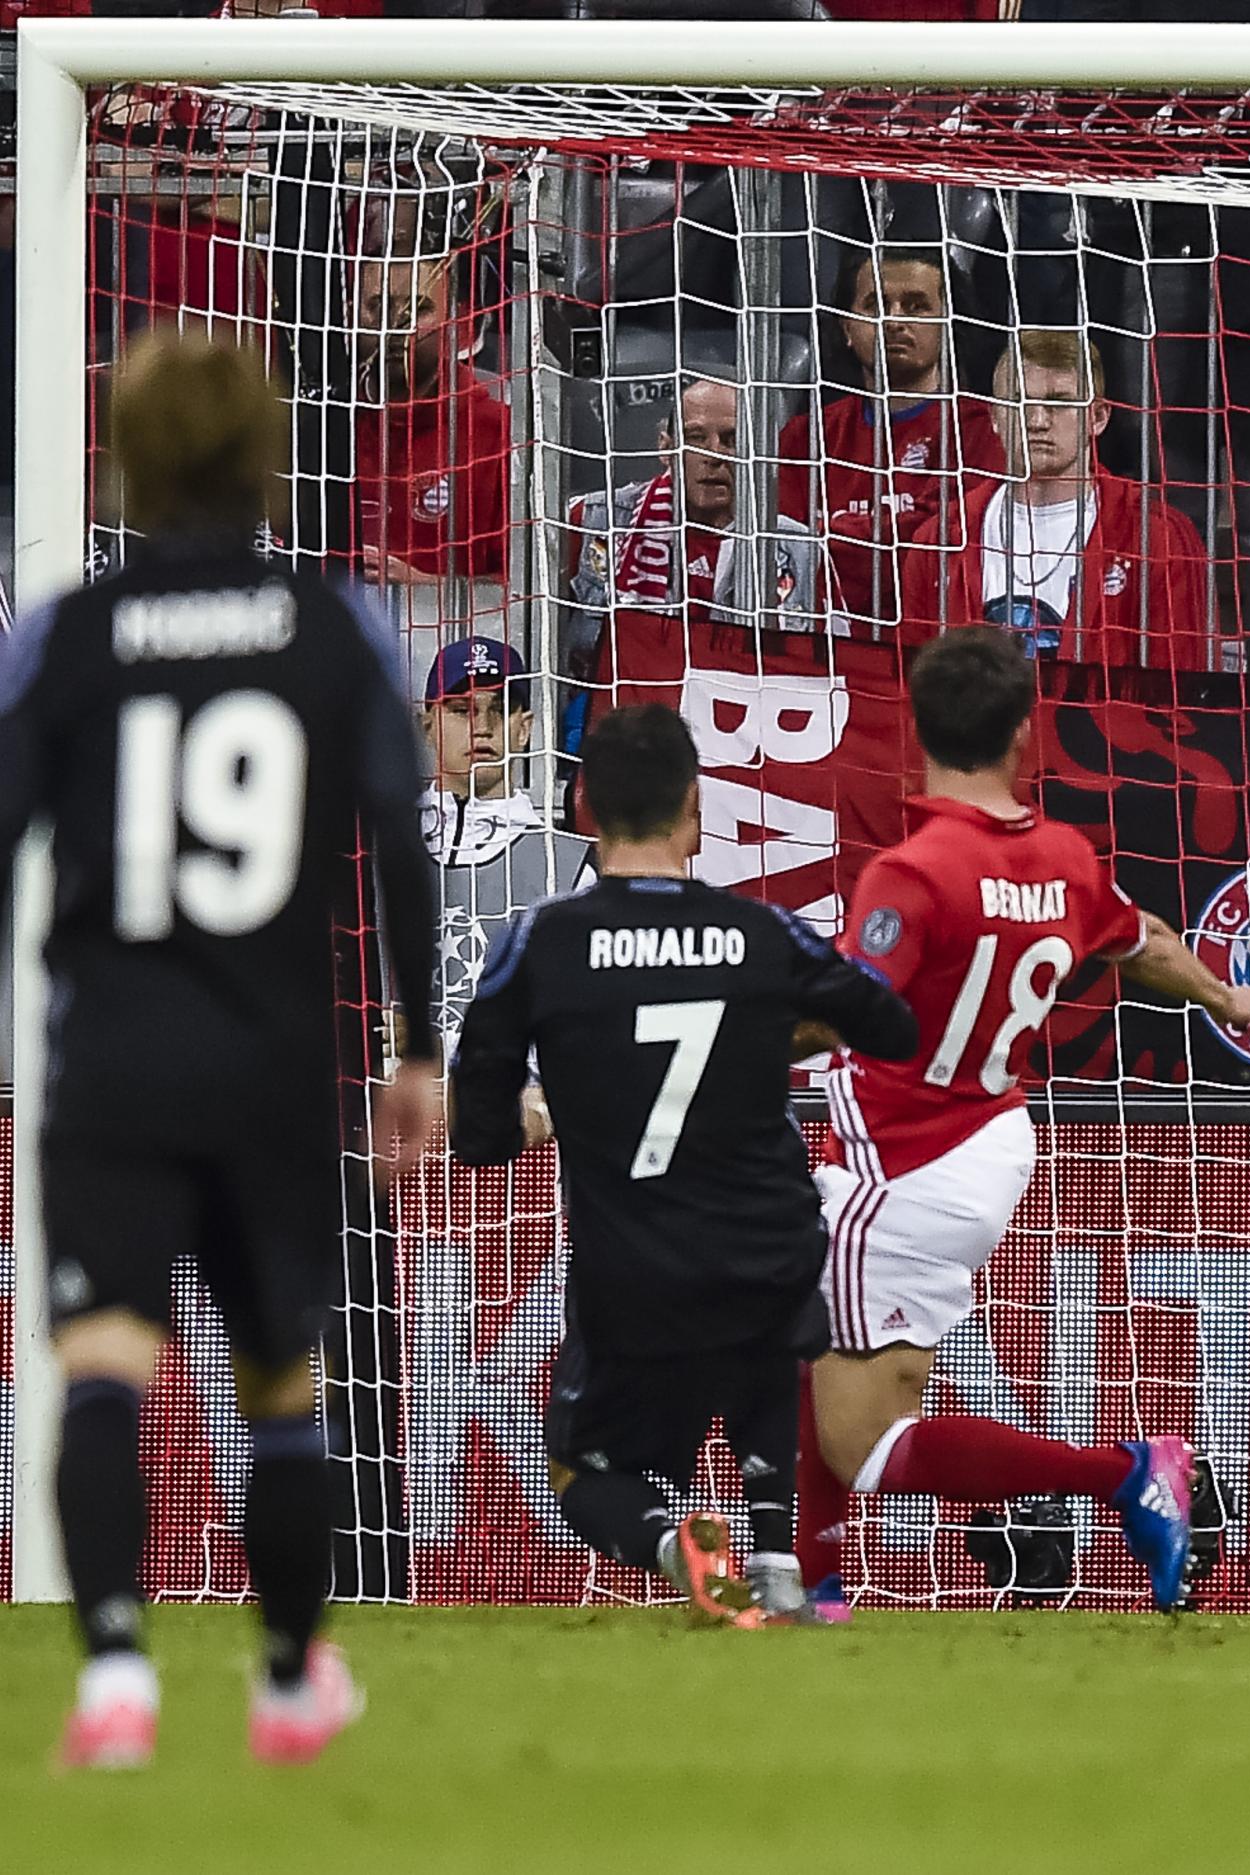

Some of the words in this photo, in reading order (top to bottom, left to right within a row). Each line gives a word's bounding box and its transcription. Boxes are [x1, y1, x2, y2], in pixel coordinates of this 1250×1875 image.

[113, 688, 309, 943] 19
[590, 926, 747, 970] RONALDO
[980, 876, 1067, 923] BERNAT
[1205, 901, 1242, 948] FC
[923, 933, 1074, 1096] 18
[630, 999, 727, 1180] 7
